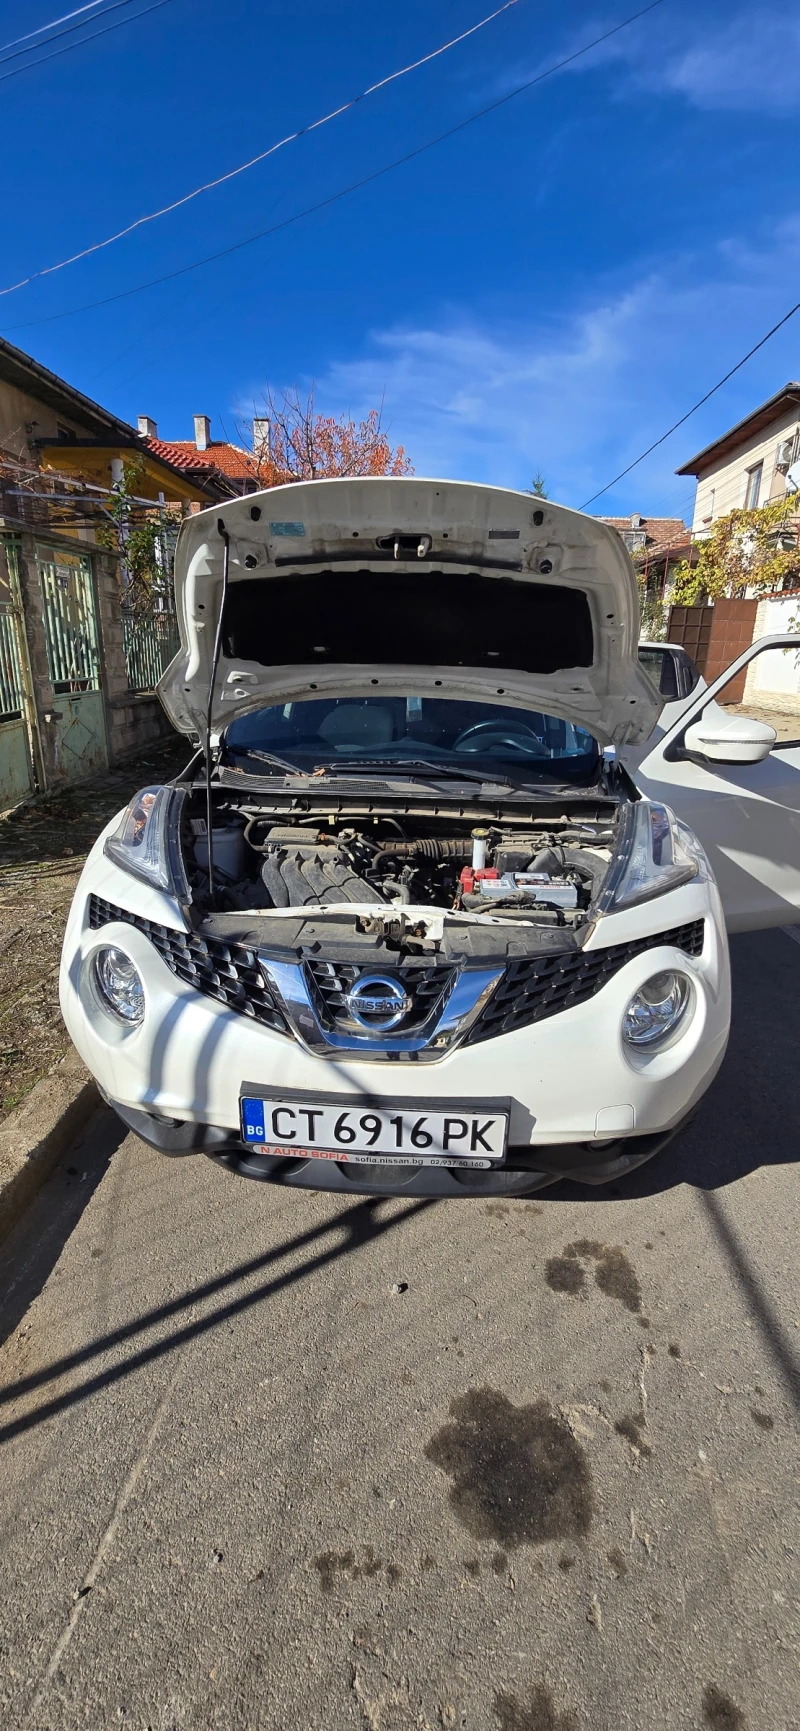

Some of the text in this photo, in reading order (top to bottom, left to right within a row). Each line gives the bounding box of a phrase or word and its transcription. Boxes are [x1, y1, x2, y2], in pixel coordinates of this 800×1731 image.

[351, 1000, 404, 1011] NISSAN
[247, 1125, 264, 1135] BG
[272, 1107, 497, 1152] CT 6916 PK
[260, 1146, 349, 1161] N AUTO SOFIA
[355, 1156, 424, 1165] sofia.nissan.bg
[430, 1159, 457, 1167] 02/937
